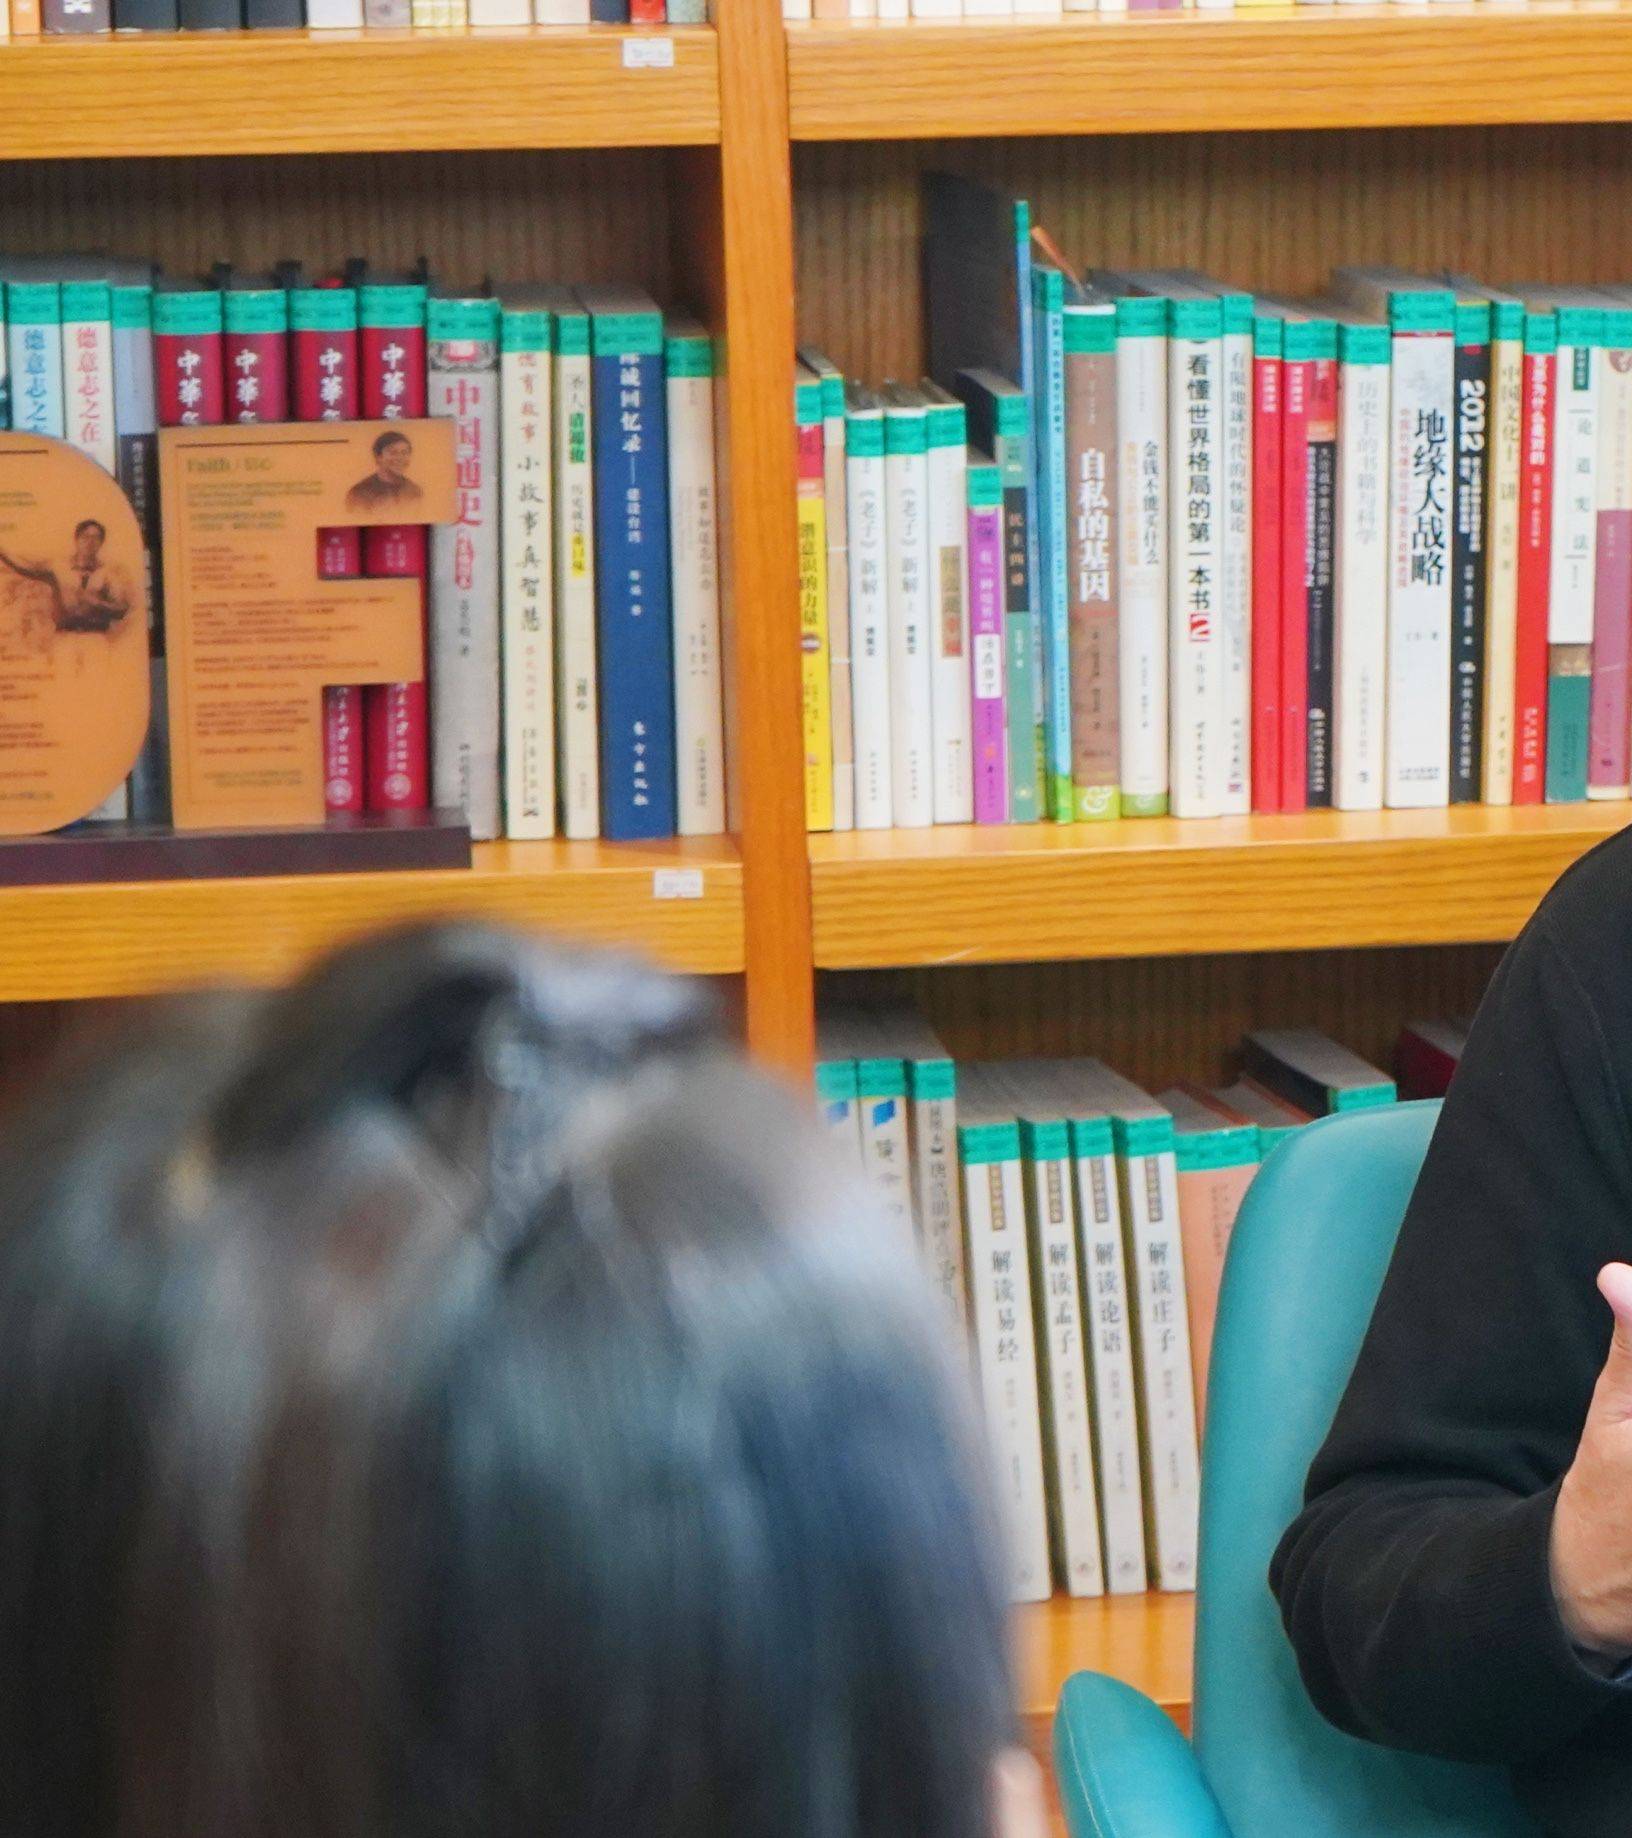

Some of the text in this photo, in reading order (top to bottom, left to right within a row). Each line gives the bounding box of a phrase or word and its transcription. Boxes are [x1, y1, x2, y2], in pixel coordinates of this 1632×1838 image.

[1459, 379, 1486, 453] 2012
[1078, 447, 1111, 602] 自私的基因
[1186, 353, 1212, 611] 看懂世界格局的第一本书
[1412, 407, 1449, 587] 地缘大战略
[516, 455, 545, 632] 小故事真智慧
[992, 1250, 1019, 1362] 解读易经
[1049, 1243, 1075, 1355] 解读孟子
[1095, 1242, 1121, 1354] 解读论语
[1148, 1241, 1176, 1353] 解读庄子
